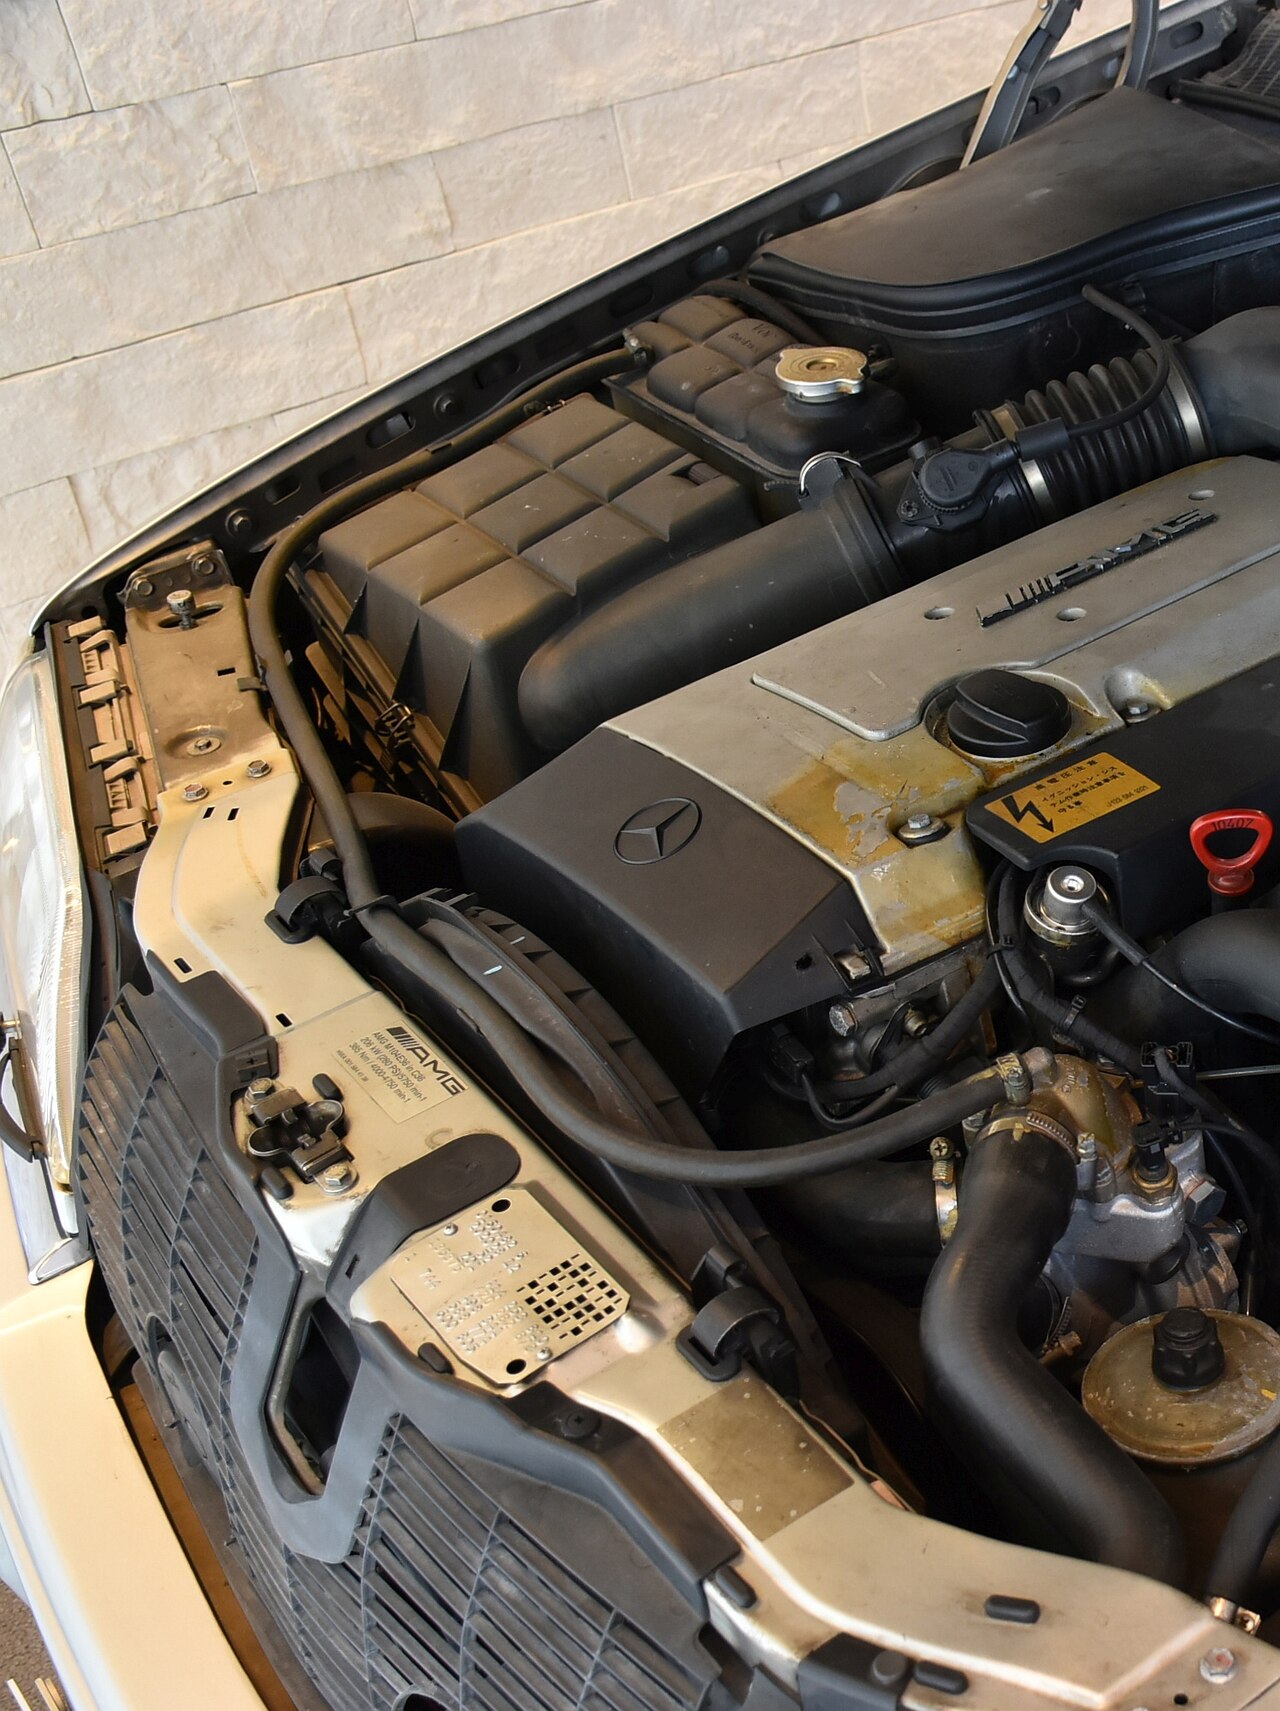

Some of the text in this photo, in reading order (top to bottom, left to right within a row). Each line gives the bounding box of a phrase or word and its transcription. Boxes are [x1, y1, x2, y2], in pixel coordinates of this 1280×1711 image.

[358, 1051, 370, 1062] Nm
[394, 1087, 411, 1103] min-1
[371, 1045, 382, 1055] kW
[410, 1085, 427, 1101] min-1
[373, 1032, 426, 1082] AMG M104E36 in C36
[406, 1045, 466, 1096] AMG
